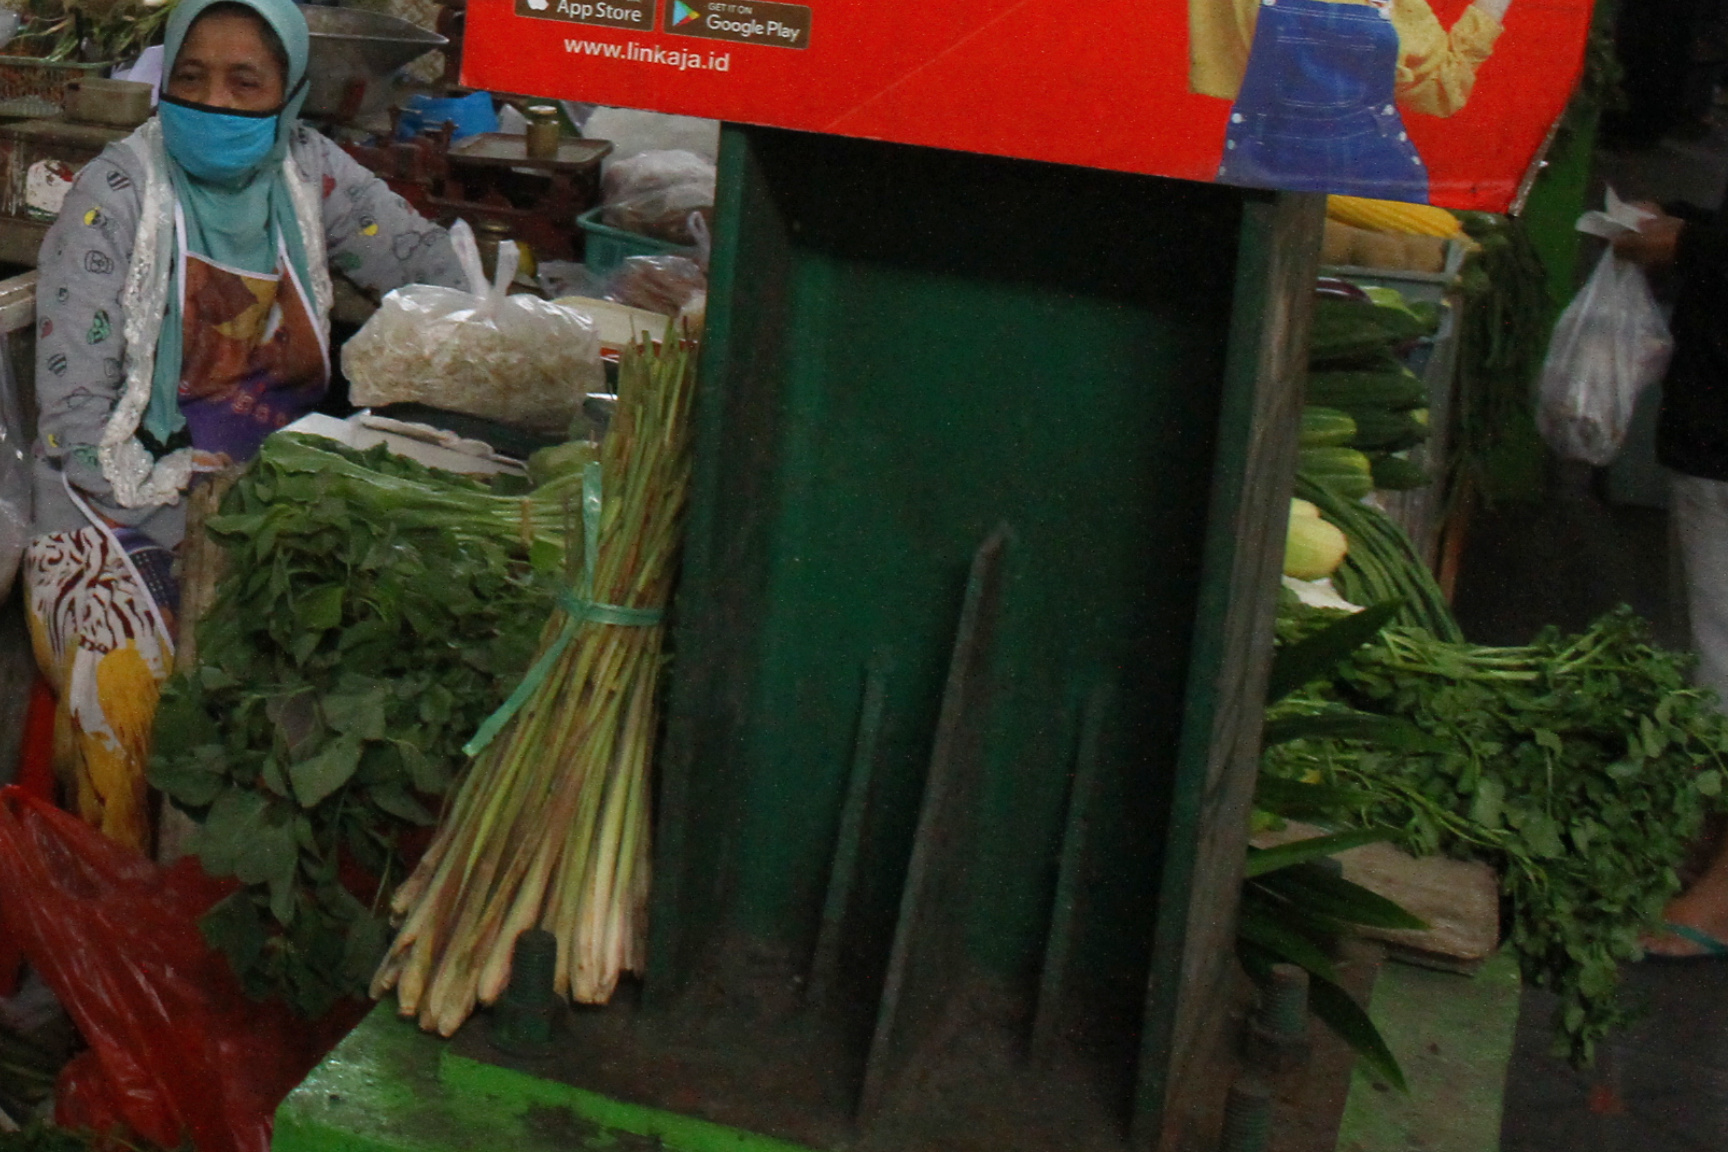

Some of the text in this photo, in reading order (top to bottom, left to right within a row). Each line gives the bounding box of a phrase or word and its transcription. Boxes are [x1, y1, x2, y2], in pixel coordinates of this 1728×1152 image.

[595, 0, 643, 22] Store
[707, 1, 753, 15] GET IT ON
[705, 13, 801, 42] Google Play
[563, 37, 731, 72] www.linkaja.id
